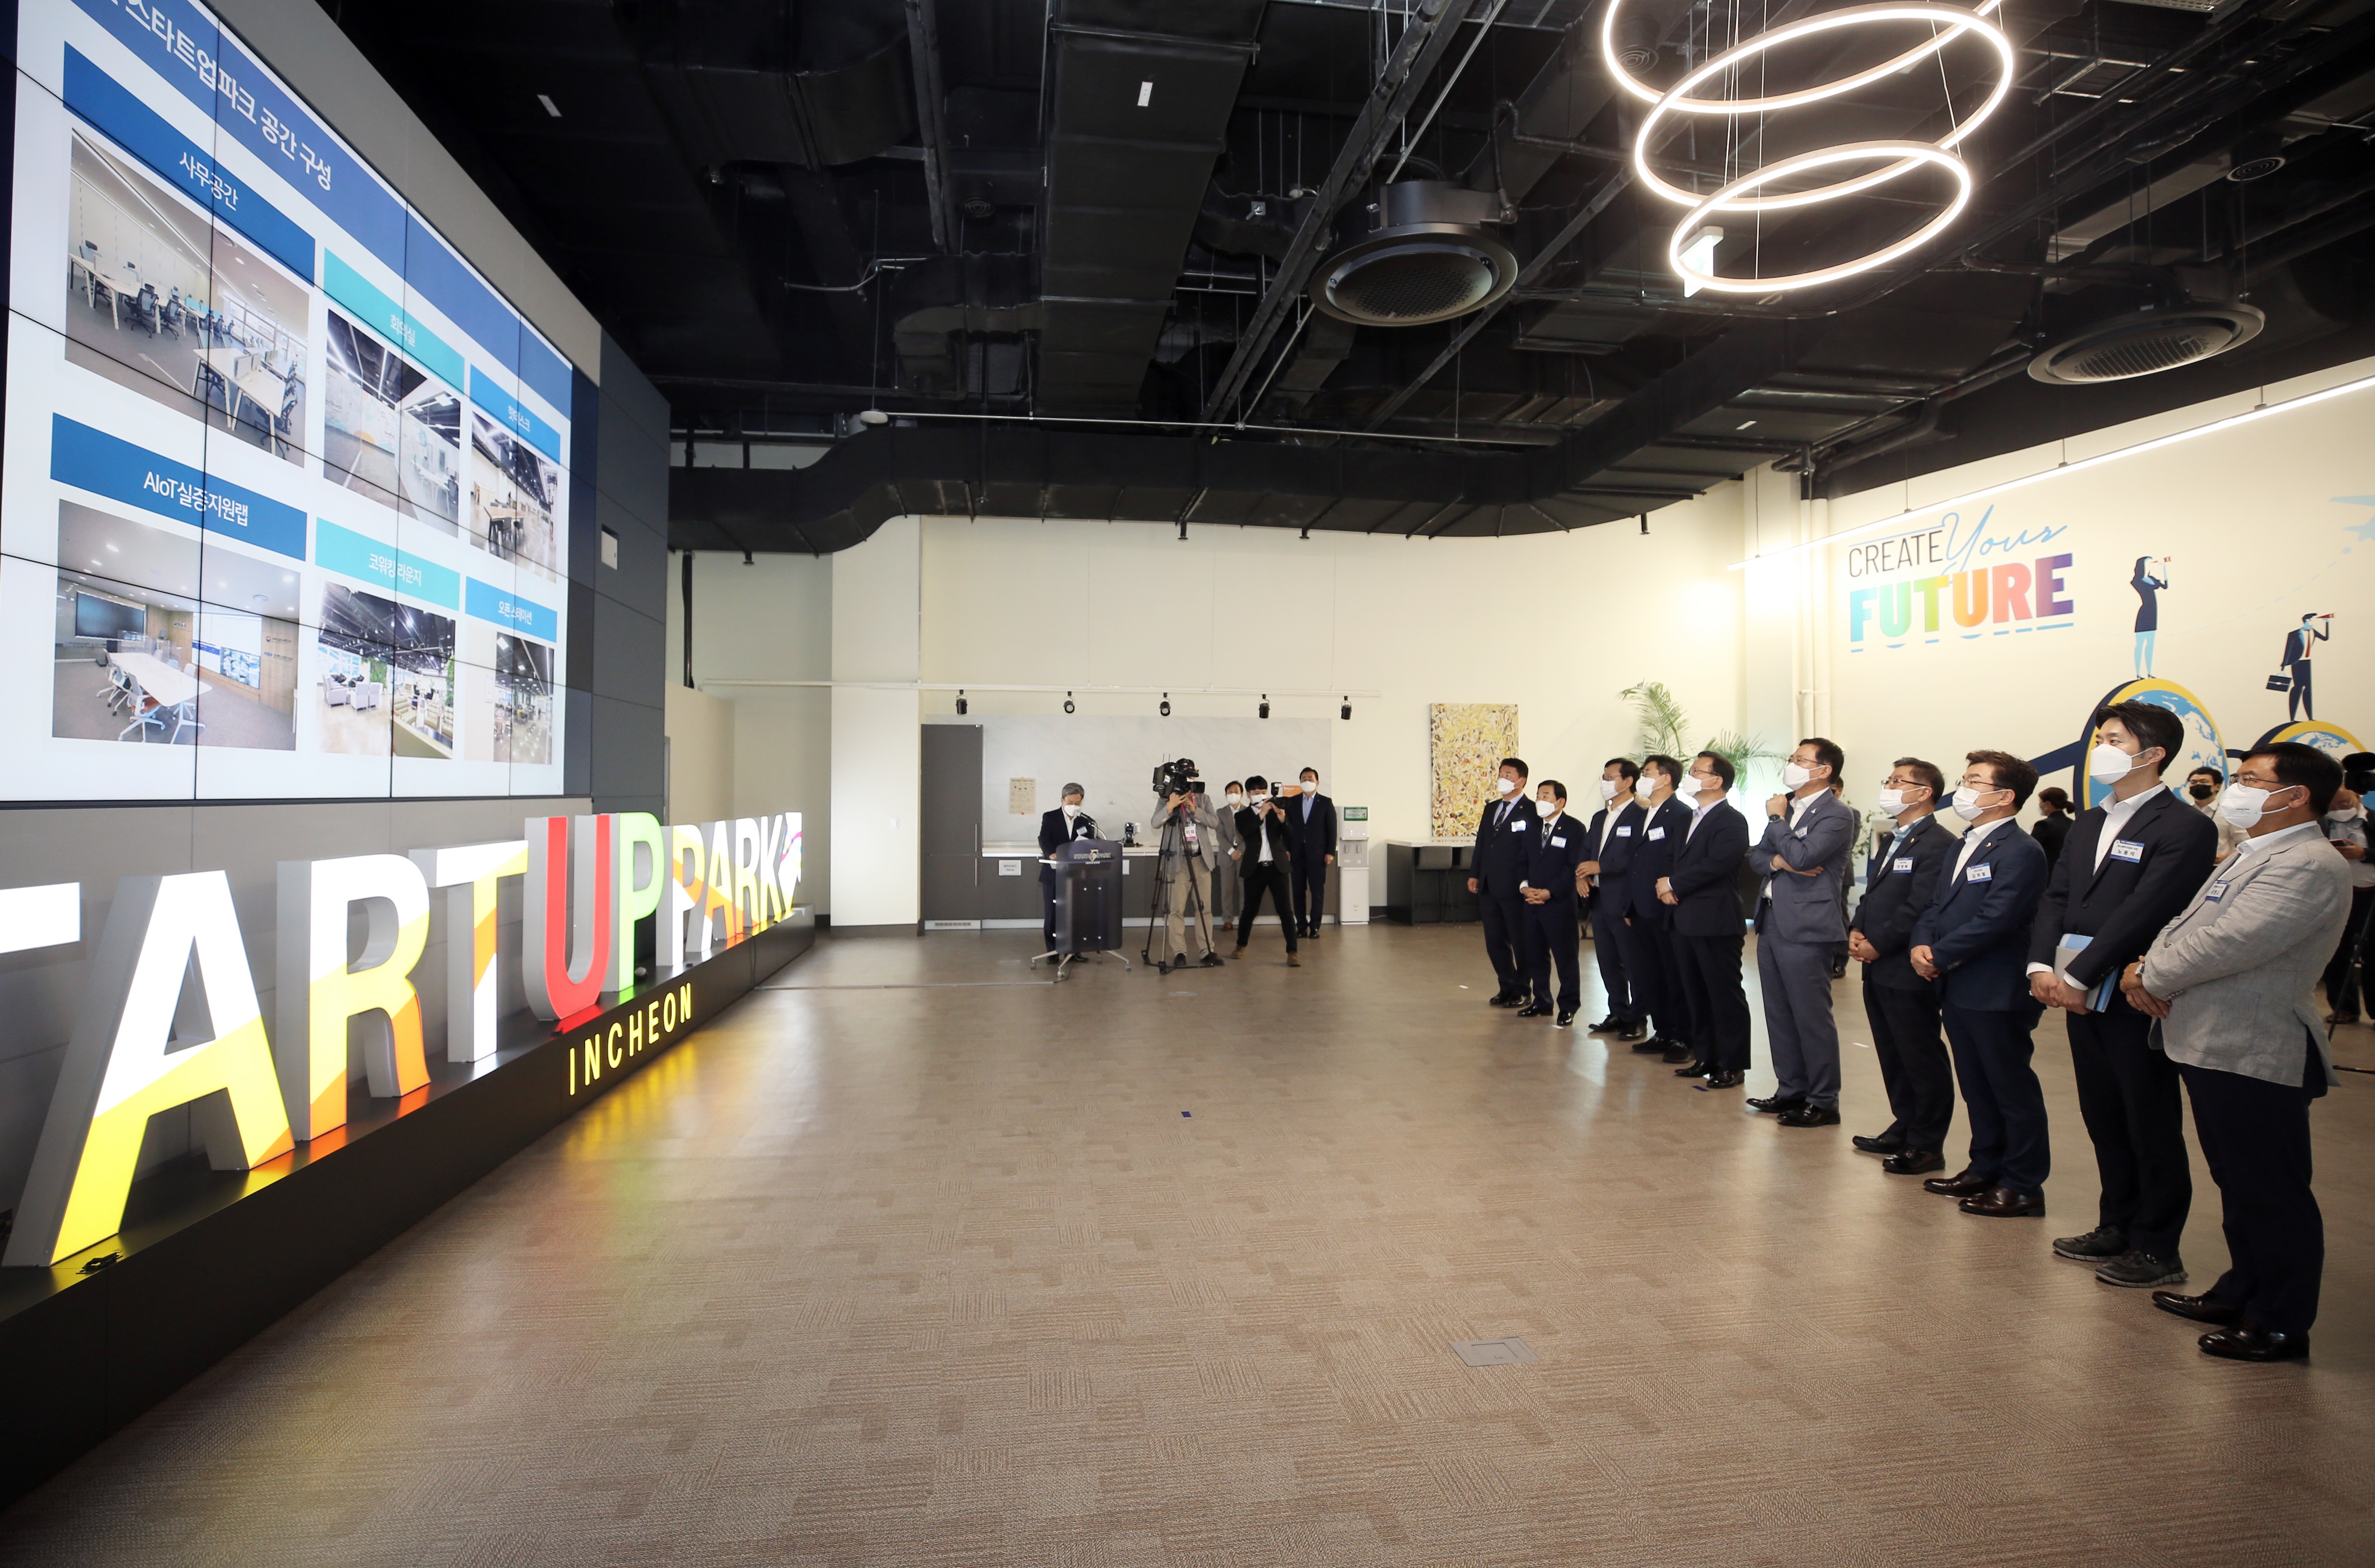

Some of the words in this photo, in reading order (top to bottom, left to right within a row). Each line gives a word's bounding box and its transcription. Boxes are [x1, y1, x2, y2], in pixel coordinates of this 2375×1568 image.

[179, 152, 239, 211] 사무공간
[260, 107, 297, 161] 공간
[299, 142, 331, 191] 구성
[390, 315, 415, 347] 회의실
[508, 405, 530, 432] 핫데스크
[1848, 530, 1944, 578] CREATE
[1940, 504, 2068, 578] Your
[1850, 553, 2074, 642] FUTURE
[569, 982, 692, 1096] INCHEON
